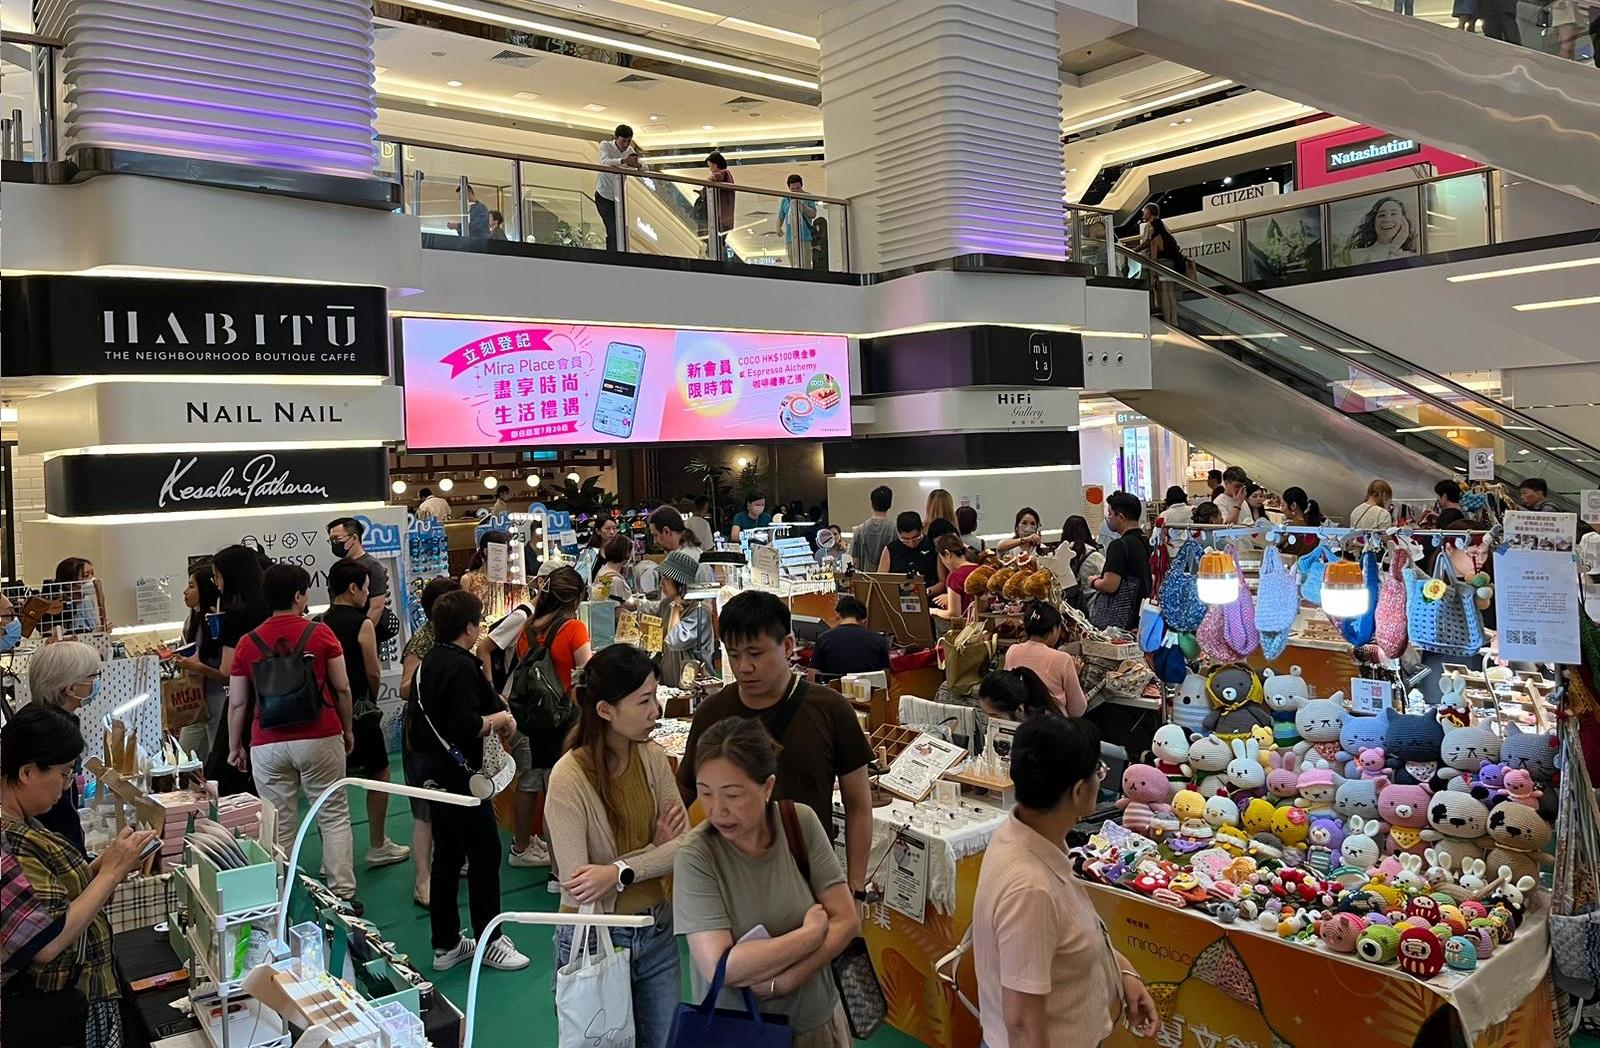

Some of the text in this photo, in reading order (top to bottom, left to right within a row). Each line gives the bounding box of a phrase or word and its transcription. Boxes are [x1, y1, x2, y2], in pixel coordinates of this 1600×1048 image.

[1210, 185, 1265, 207] CITIZEN
[104, 351, 130, 360] THE
[135, 351, 250, 361] NEIGHBOURHOOD
[255, 352, 316, 362] BOUTIQUE
[463, 332, 532, 364] 立刻登記
[483, 360, 515, 376] Mira
[687, 359, 733, 380] 新會員
[738, 355, 760, 366] COCO
[747, 367, 783, 378] Espresso
[785, 363, 817, 374] Alchemy
[494, 373, 579, 400] 盡享時尚
[687, 380, 733, 399] 限時賞
[998, 394, 1031, 404] HiFi
[494, 397, 580, 425] 生活禮遇
[1011, 406, 1043, 420] Gallery
[171, 688, 201, 706] MUJI
